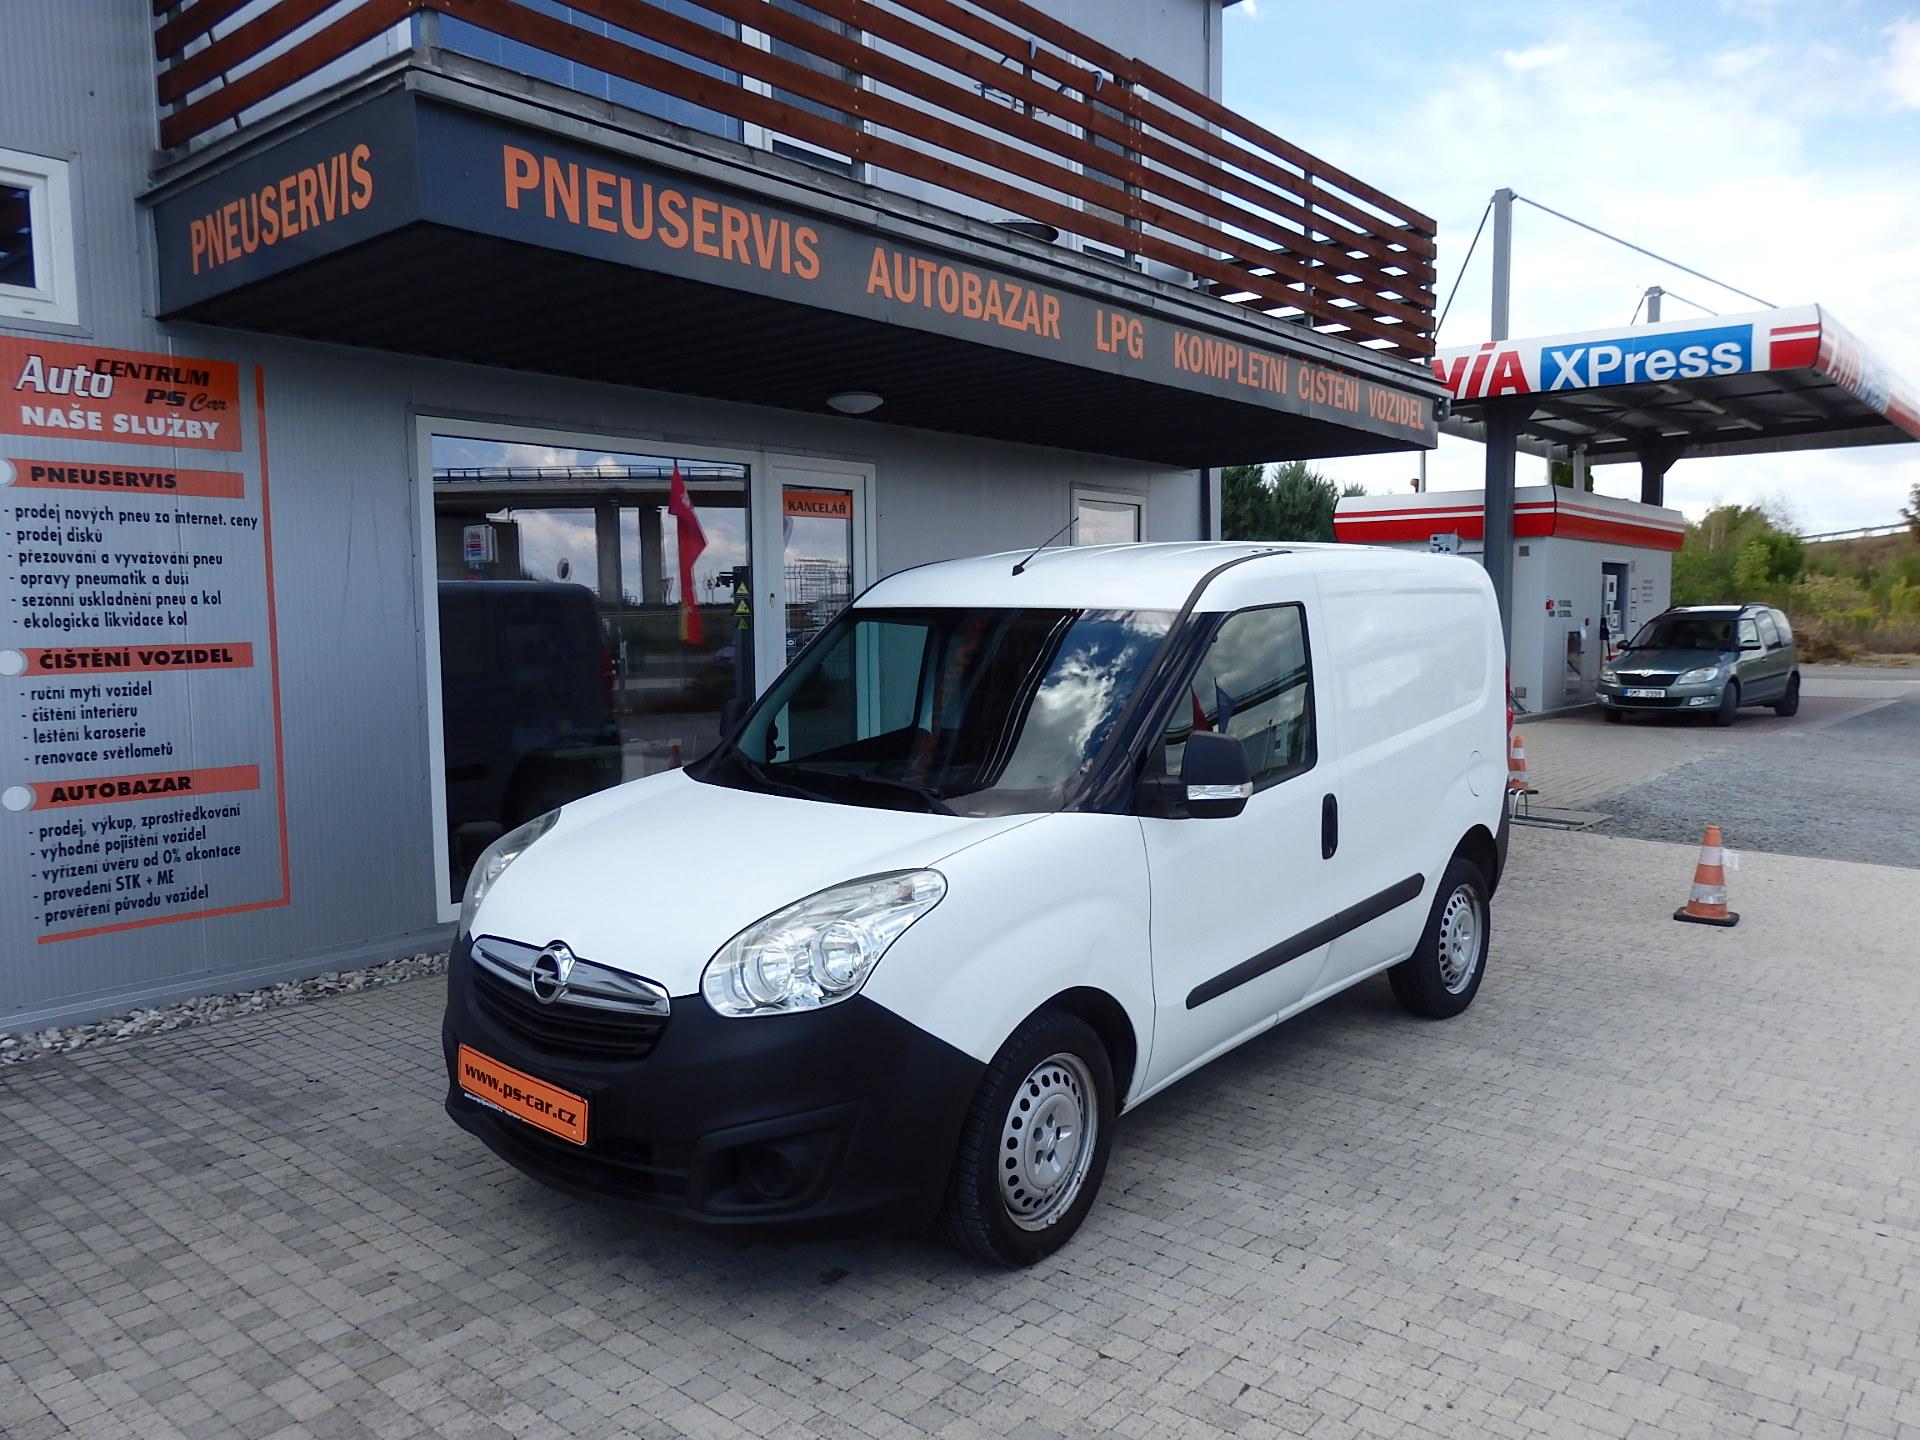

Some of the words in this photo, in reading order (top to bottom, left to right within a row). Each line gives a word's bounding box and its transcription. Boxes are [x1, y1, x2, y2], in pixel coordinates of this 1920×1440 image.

[190, 144, 373, 276] PNEUSERVIS
[503, 145, 821, 281] PNEUSERVIS
[866, 247, 1061, 340] AUTOBAZAR
[1096, 309, 1144, 360] LPG
[1173, 330, 1288, 395] KOMPLETNÍ
[1368, 385, 1425, 430] VOZIDEL
[14, 354, 114, 399] Auto
[94, 358, 210, 387] CENTRUM
[1549, 341, 1743, 392] XPress
[145, 388, 187, 407] PS
[188, 392, 229, 412] Car
[21, 403, 103, 431] NAŠE
[113, 412, 219, 440] SLUŽBY
[31, 466, 177, 489] PNEUSERVIS
[15, 504, 61, 522] prodej
[65, 506, 114, 524] nových
[119, 511, 151, 525] pneu
[155, 513, 170, 524] za
[175, 510, 226, 527] internet.
[231, 515, 258, 530] ceny
[788, 500, 846, 515] KANCELÁŘ
[17, 527, 62, 545] prodej
[67, 527, 103, 543] disků
[19, 550, 96, 566] přezouvání
[102, 554, 109, 563] a
[115, 551, 189, 568] vyvažování
[194, 554, 223, 568] pneu
[20, 574, 70, 588] opravy
[76, 571, 146, 588] pneumatik
[152, 575, 160, 585] a
[22, 592, 74, 607] sezónní
[79, 591, 152, 607] uskladnění
[156, 595, 186, 608] pneu
[191, 596, 198, 605] a
[203, 590, 222, 605] kol
[24, 613, 99, 632] ekologická
[105, 611, 163, 627] likvidace
[168, 611, 188, 626] kol
[39, 648, 131, 670] ČIŠTĚNÍ
[137, 648, 233, 666] VOZIDEL
[31, 686, 65, 701] ruční
[106, 681, 152, 697] vozidel
[32, 706, 76, 722] čištění
[81, 703, 138, 720] interiéru
[34, 728, 79, 743] leštění
[84, 723, 146, 740] karoserie
[35, 750, 98, 765] renovace
[103, 742, 173, 761] světlometů
[50, 776, 192, 802] AUTOBAZAR
[39, 818, 86, 841] prodej,
[92, 815, 136, 835] výkup,
[141, 803, 240, 830] zprostředkování
[40, 840, 100, 862] výhodné
[105, 834, 158, 853] pojištění
[163, 825, 206, 844] vozidel
[42, 863, 97, 883] vyřízení
[102, 855, 139, 873] úvěru
[143, 851, 159, 867] od
[163, 848, 181, 864] 0%
[185, 844, 241, 862] akontace
[44, 882, 112, 905] provedení
[115, 874, 141, 891] STK
[146, 876, 153, 885] +
[157, 869, 174, 886] ME
[45, 904, 111, 926] prověření
[115, 892, 161, 915] původu
[165, 884, 209, 905] vozidel
[464, 1062, 577, 1127] www.ps-car.cz
